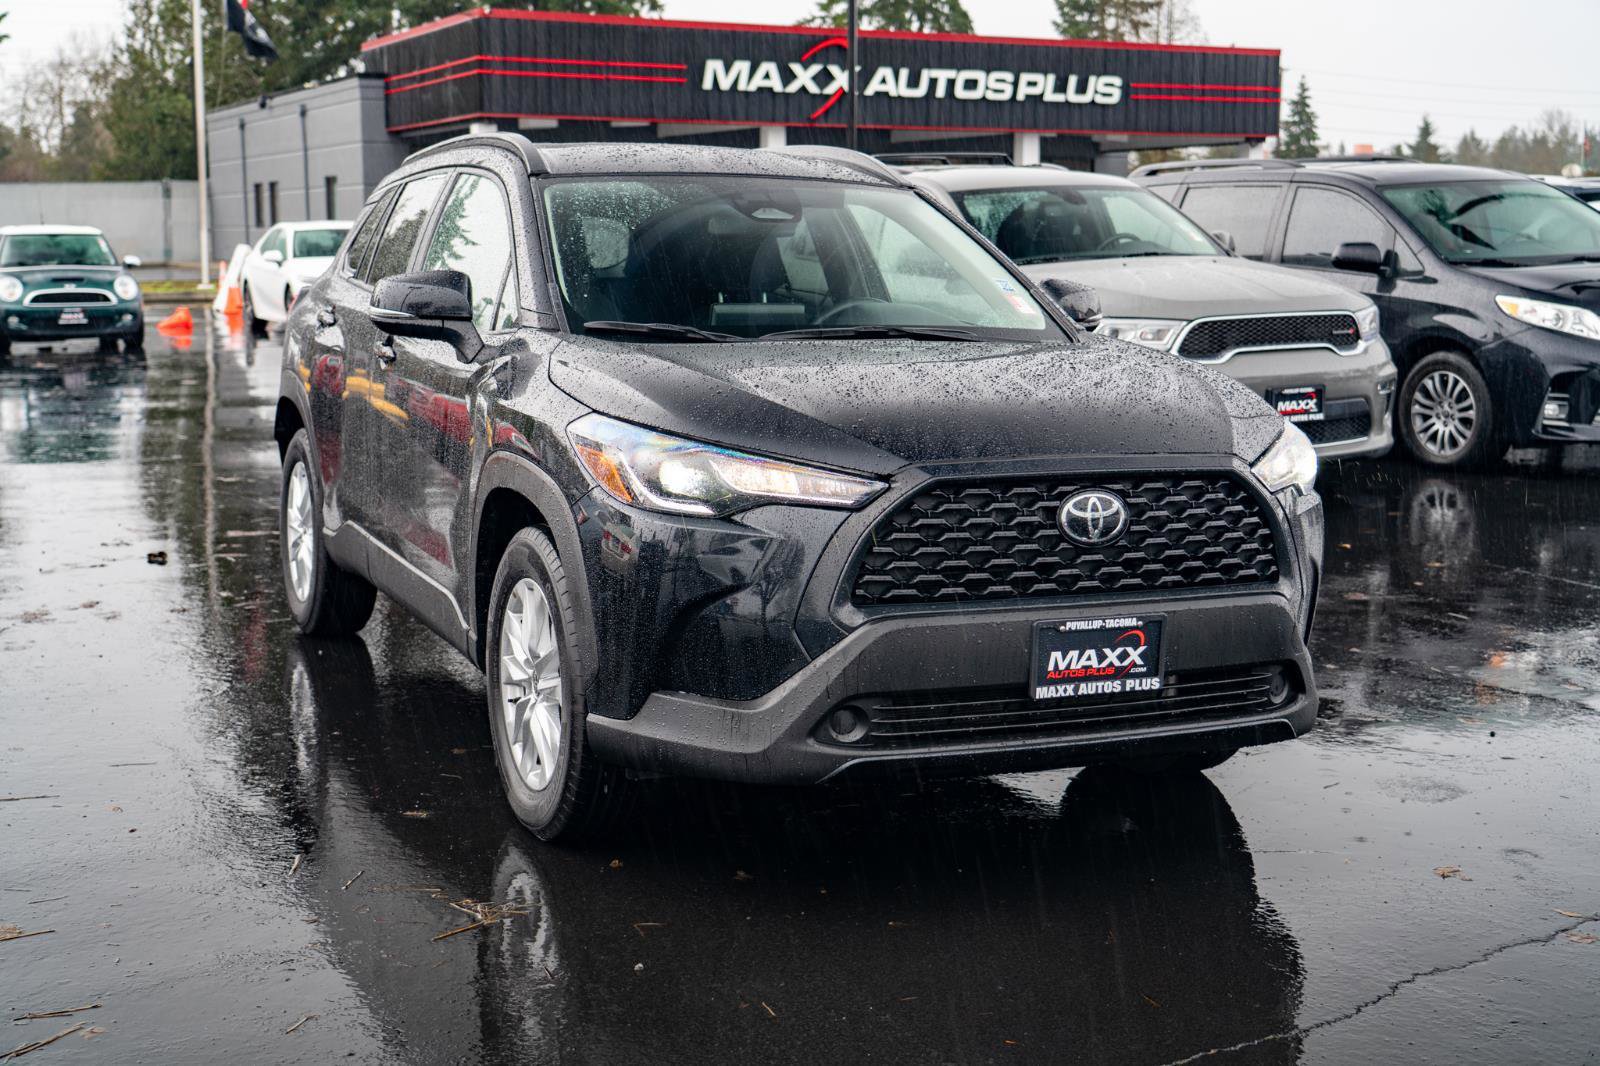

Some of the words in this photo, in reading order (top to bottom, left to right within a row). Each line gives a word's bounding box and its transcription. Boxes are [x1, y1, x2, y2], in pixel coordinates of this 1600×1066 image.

[863, 66, 1015, 101] AUTOS
[1016, 72, 1123, 105] PLUS
[1277, 399, 1317, 411] MAXX
[1047, 645, 1147, 671] MAXX
[1047, 669, 1085, 679] AUTOS
[1087, 667, 1115, 675] PLUS
[1035, 685, 1075, 699] MAXX
[1078, 681, 1121, 696] AUTOS
[1125, 678, 1160, 692] PLUS
